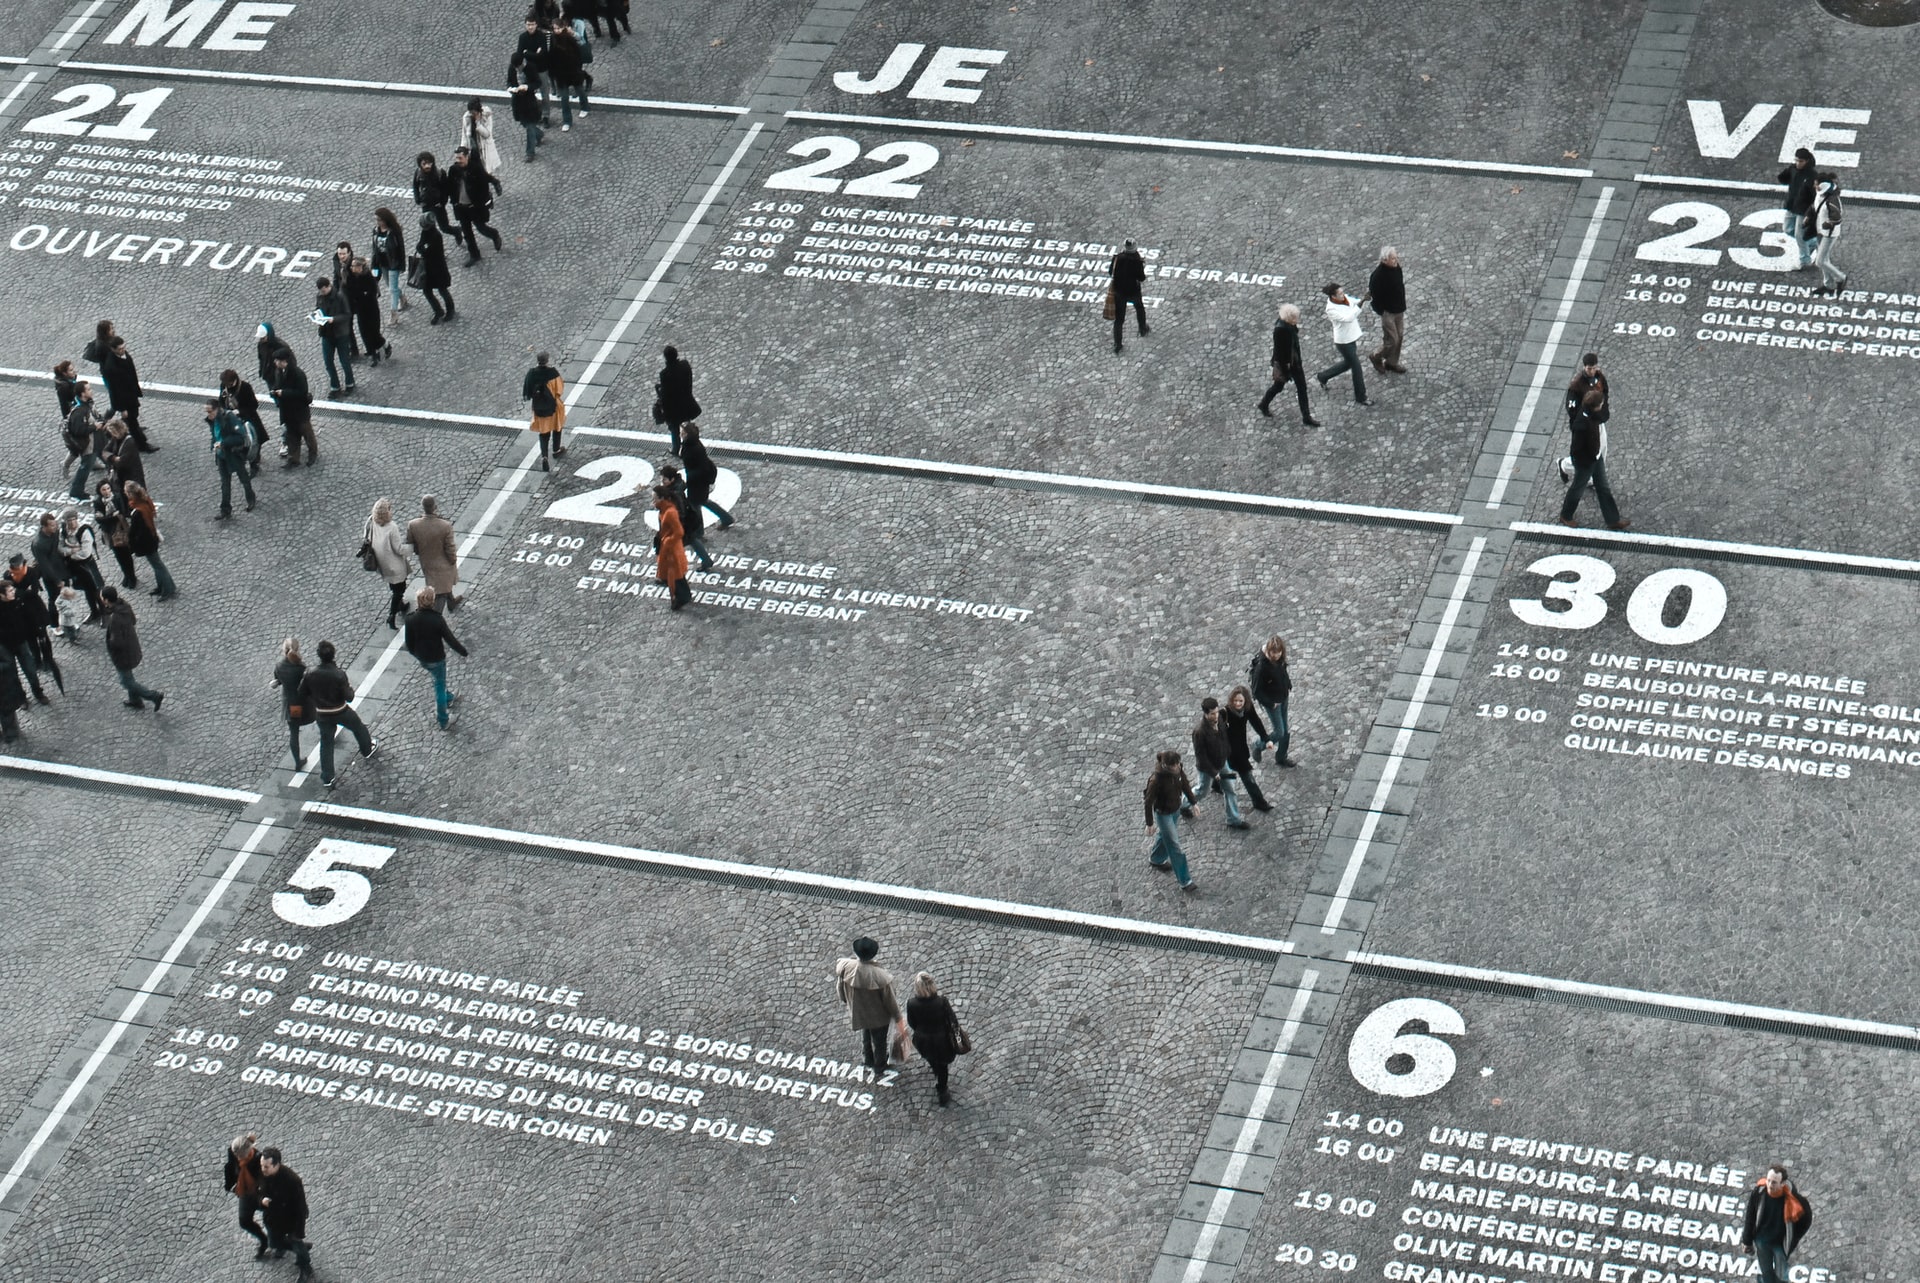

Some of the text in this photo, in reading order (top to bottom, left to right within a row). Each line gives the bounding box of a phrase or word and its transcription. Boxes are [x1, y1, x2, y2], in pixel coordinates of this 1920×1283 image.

[102, 0, 296, 51] ME
[833, 43, 1008, 104] JE
[20, 83, 174, 141] 21
[1687, 100, 1872, 168] VE
[20, 154, 44, 164] 30
[55, 156, 239, 182] BEAUBOURG-LA-REINE:
[240, 173, 344, 191] COMPAGNIE
[341, 182, 370, 194] DU
[34, 141, 56, 150] 00
[68, 144, 133, 158] FORUM:
[133, 149, 202, 164] FRANCK
[201, 154, 283, 171] LEIBOVICI
[763, 135, 940, 199] 22
[9, 167, 308, 203] 00 BRUITS DE BOUCHE: DAVID MOSS
[84, 204, 136, 218] DAVID
[89, 189, 179, 206] CHRISTIAN
[178, 197, 232, 211] RIZZO
[738, 216, 1161, 260] 15 00 BEAUBOURG-LA-REINE: LES KELLRS
[749, 201, 1036, 234] 14 00 UNE PEINTURE PARLÉE
[9, 224, 324, 279] OUVERTURE
[720, 245, 988, 278] 20 00 TEATRINO PALERMO:
[729, 231, 1287, 288] 19 00 BEAUBOURG-LA-REINE: JULIE NICE ET SIR ALICE
[711, 260, 1065, 301] 20 30 GRANDE SALLE: ELMGREEN &
[1623, 288, 1687, 304] 16 00
[1629, 273, 1757, 294] 14 00 UNE
[1612, 321, 1644, 335] 19
[1646, 324, 1676, 337] 00
[1701, 312, 1776, 329] GILLES
[523, 532, 837, 580] 14 00 UNE PARLÉE
[511, 550, 1034, 623] 16 00 LAURENT FRIQUET
[576, 576, 867, 622] ET BRÉBANT
[1509, 554, 1727, 645] 30
[1490, 663, 1523, 678] 16
[1528, 667, 1561, 682] 00
[1583, 672, 1868, 717] BEAUBOURG-LA-REINE:
[1497, 643, 1867, 695] 14 00 UNE PEINTURE PARLÉE
[1475, 703, 1509, 718] 19
[1514, 707, 1548, 723] 00
[1576, 693, 1920, 745] SOPHIE LENOIR ET STÉPHAN
[1564, 734, 1851, 779] GUILLAUME DÉSANGES
[271, 838, 397, 927] 5
[236, 937, 584, 1007] 14 00 UNE PEINTURE PARLÉE
[220, 959, 753, 1061] 14 00 TEATRINO PALERMO, CINÉMA 2: BORIS
[204, 982, 877, 1115] 16 00 BEAUBOURG-LA-REINE: GILLES GASTON-DREYFUS,
[274, 1019, 705, 1107] SOPHIE LENOIR ET STÉPHANE ROGER
[1348, 997, 1466, 1098] 6
[153, 1050, 613, 1146] 20 30 GRANDE SALLE: STEVEN COHEN
[169, 1028, 775, 1146] 18 00 PARFUMS POURPRES DU SOLEIL DES PÔLES
[1323, 1110, 1747, 1189] 14 00 UNE PEINTURE PARLÉE
[1313, 1136, 1746, 1218] 16 00 BEAUBOURG-LA-REINE:
[1294, 1190, 1377, 1218] 19 00
[1410, 1179, 1744, 1247] MARIE-PIERRE BRÉBAN
[1275, 1243, 1358, 1272] 20 30
[1393, 1232, 1637, 1283] OLIVE MARTIN ET
